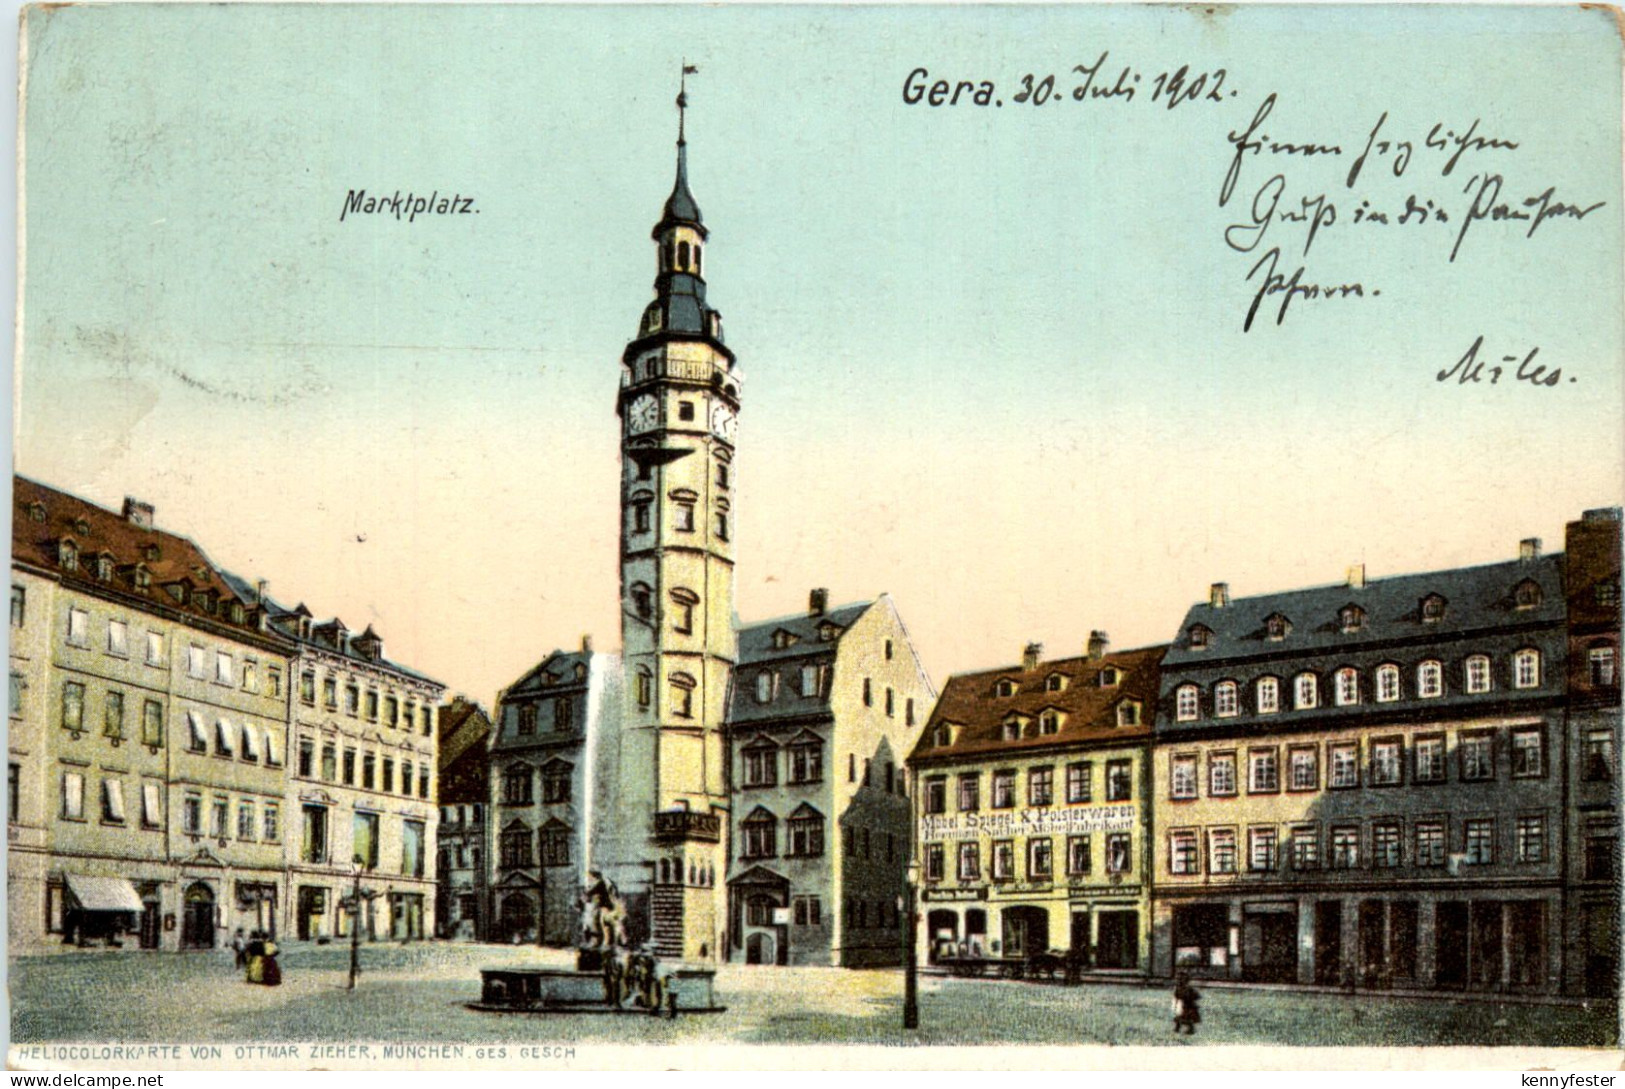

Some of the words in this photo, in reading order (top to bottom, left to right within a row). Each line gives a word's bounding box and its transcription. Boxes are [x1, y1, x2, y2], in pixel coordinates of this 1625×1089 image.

[902, 67, 1003, 107] Gera.
[1012, 73, 1063, 106] 30.
[1072, 50, 1141, 102] Juli
[1151, 64, 1238, 111] 1902.
[339, 189, 481, 223] Marktplatz.
[19, 1046, 181, 1060] HELIOCOLORKARTE
[190, 1046, 222, 1060] VON
[235, 1045, 299, 1060] OTTMAR
[310, 1045, 377, 1060] ZIEHER,
